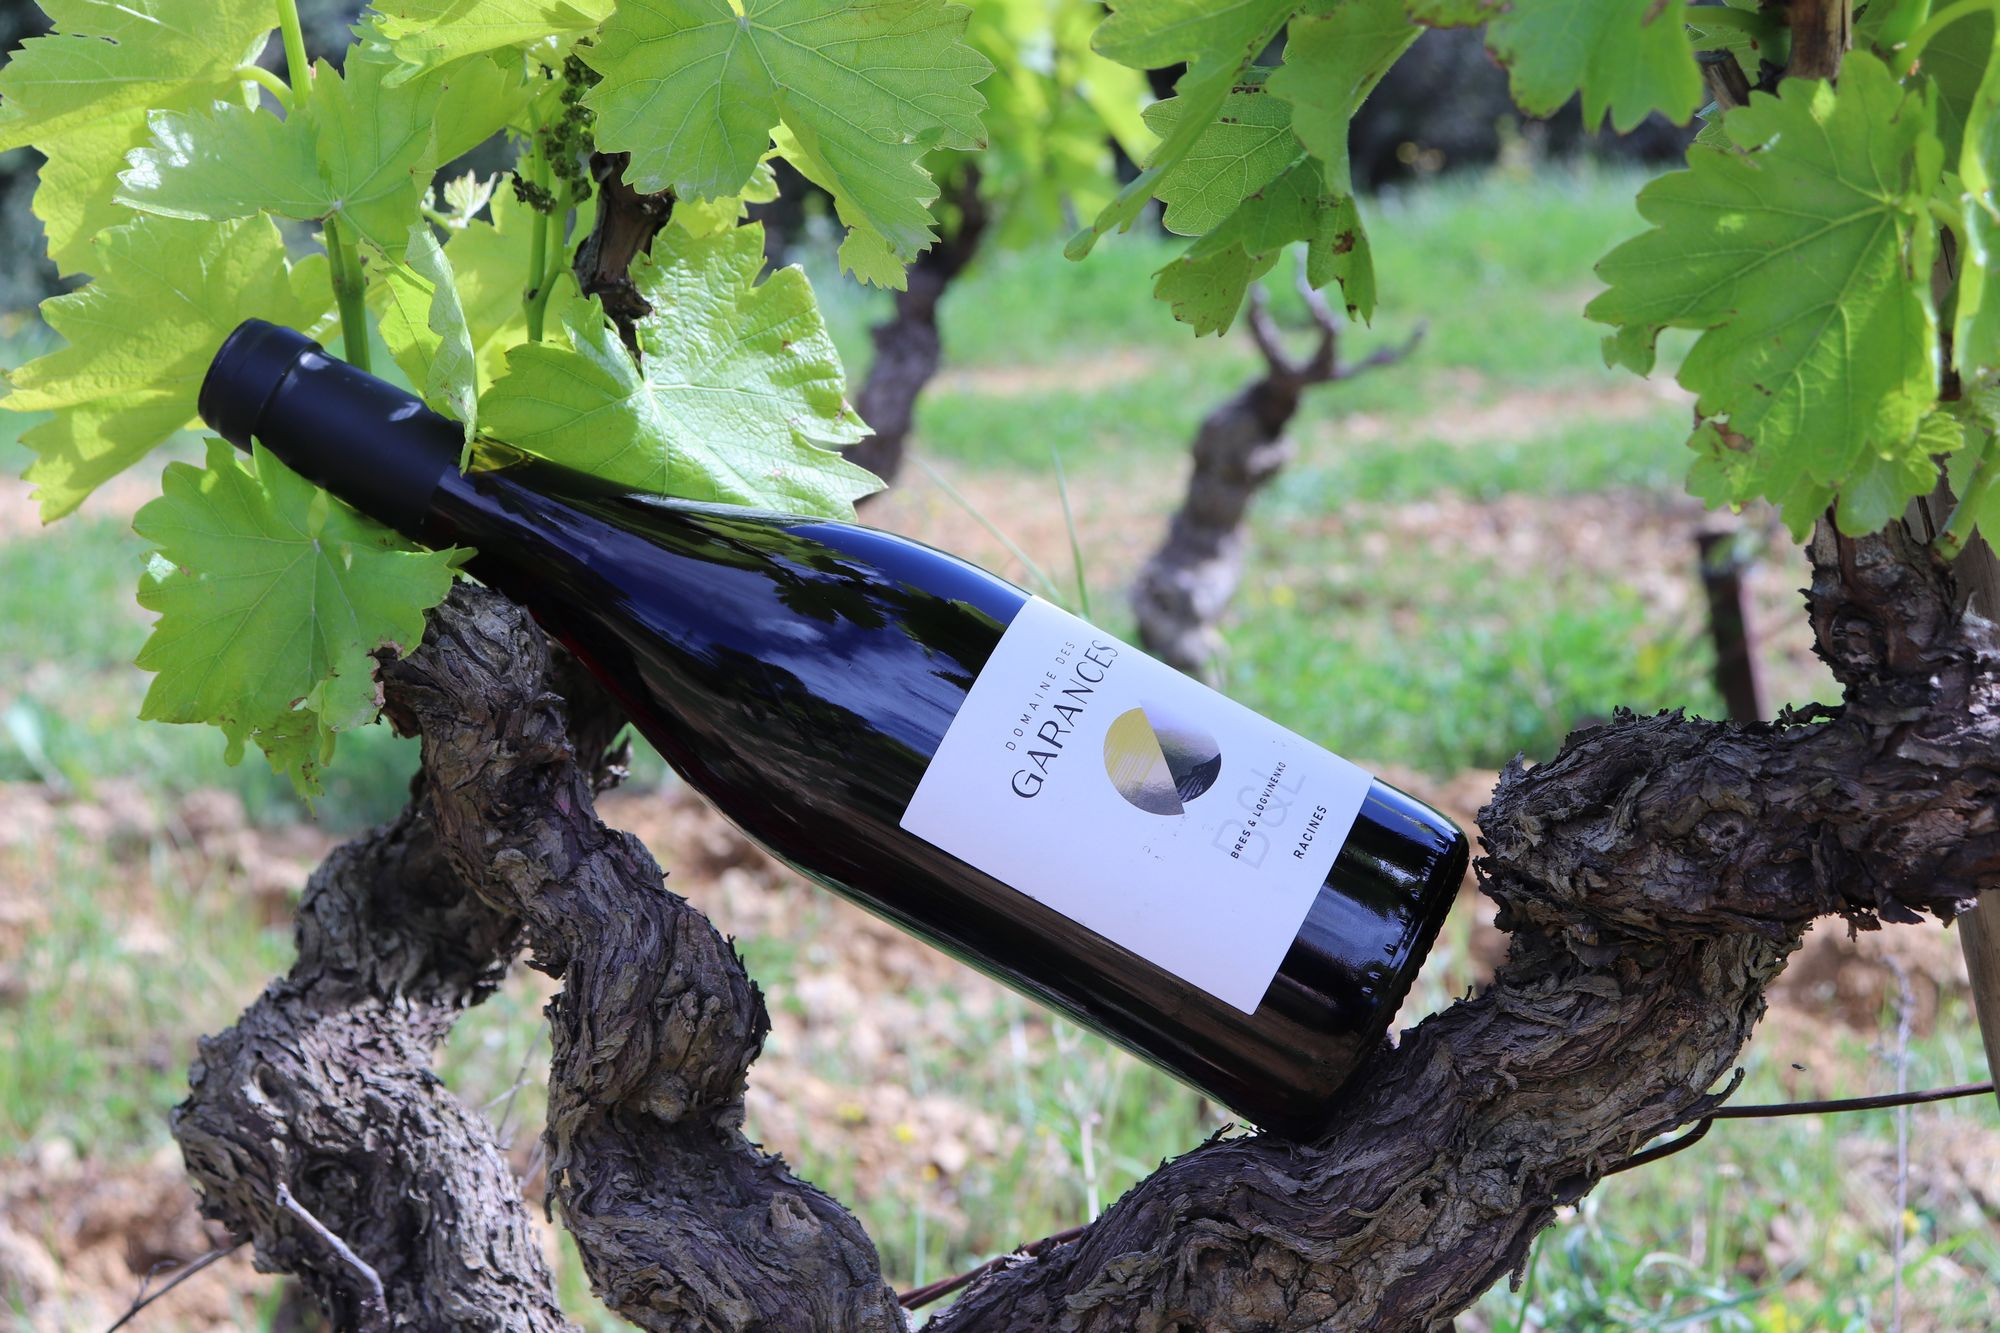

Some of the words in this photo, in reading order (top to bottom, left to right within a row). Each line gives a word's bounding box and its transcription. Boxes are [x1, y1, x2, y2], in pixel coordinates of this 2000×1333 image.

[1005, 671, 1057, 751] DOMAINE
[1055, 641, 1076, 665] DES
[1011, 640, 1119, 799] GARANCES
[1230, 829, 1251, 859] BRES
[1247, 819, 1257, 827] &
[1253, 761, 1287, 817] LOGVINENKO
[1293, 805, 1328, 859] RACINES
